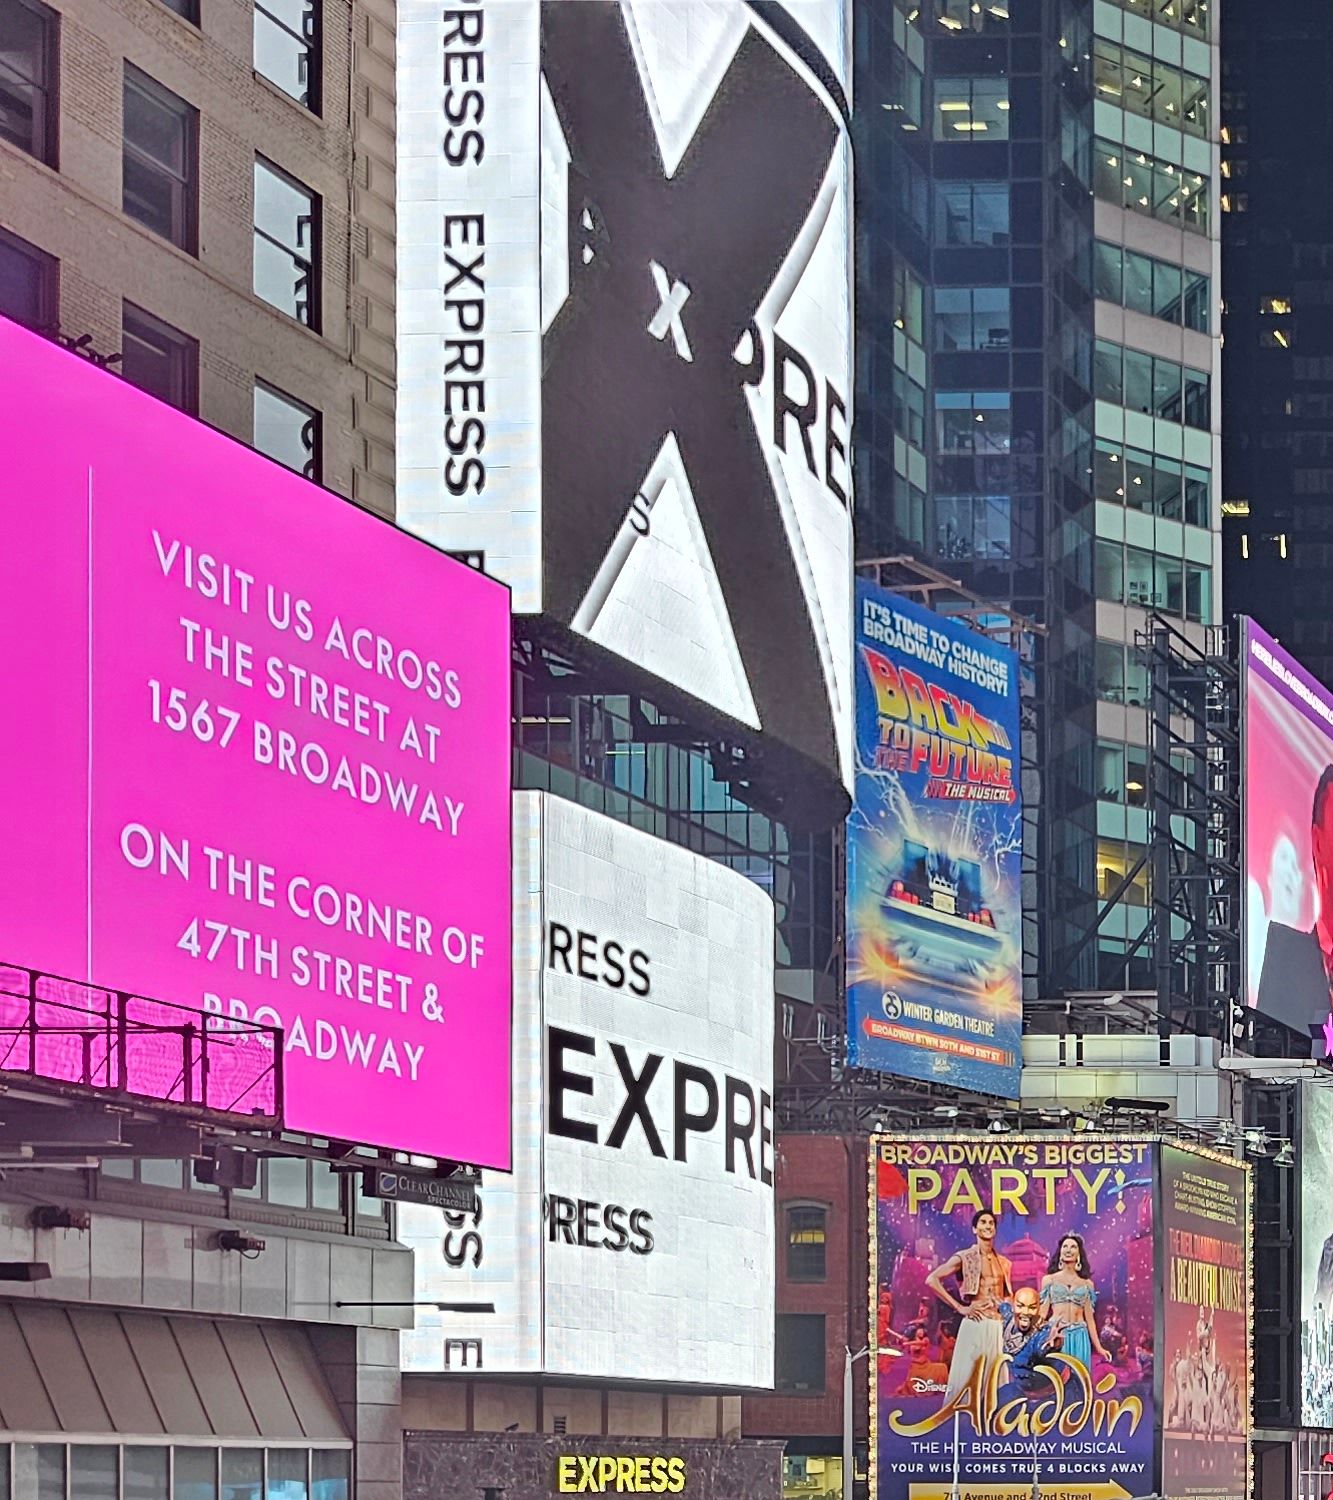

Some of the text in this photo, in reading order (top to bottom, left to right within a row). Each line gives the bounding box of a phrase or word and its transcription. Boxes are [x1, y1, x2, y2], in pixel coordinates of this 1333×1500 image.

[443, 213, 487, 498] EXPRESS
[152, 529, 463, 710] VISIT US ACROSS
[863, 598, 1009, 680] IT'S TIME TO CHANGE
[180, 616, 443, 765] THE STREET AT
[863, 617, 1009, 697] BROADWAY HISTORY!
[860, 644, 1012, 750] BACK
[147, 678, 466, 838] 1567 BROADWAY
[873, 732, 1013, 789] THE FUTURE
[877, 716, 911, 749] TO
[944, 782, 1012, 802] THE MUSICAL
[120, 823, 487, 970] ON THE CORNER OF
[176, 919, 446, 1025] 47TH STREET &
[203, 993, 425, 1083] BROADWAY
[871, 1022, 914, 1042] BROADWAY
[903, 1000, 995, 1038] WINTER GARDEN THEATRE
[880, 1143, 1149, 1166] BROADWAY'S BIGGEST
[906, 1166, 1127, 1216] PARTY!
[1177, 1257, 1220, 1309] BEAUTIFUL
[888, 1351, 1143, 1438] Aladdin
[558, 1455, 687, 1493] EXPRESS
[890, 1462, 1146, 1474] YOUR COMES TRUE 4 BLOCKS AWAY
[911, 1441, 1127, 1455] THE BROADWAY MUSICAL
